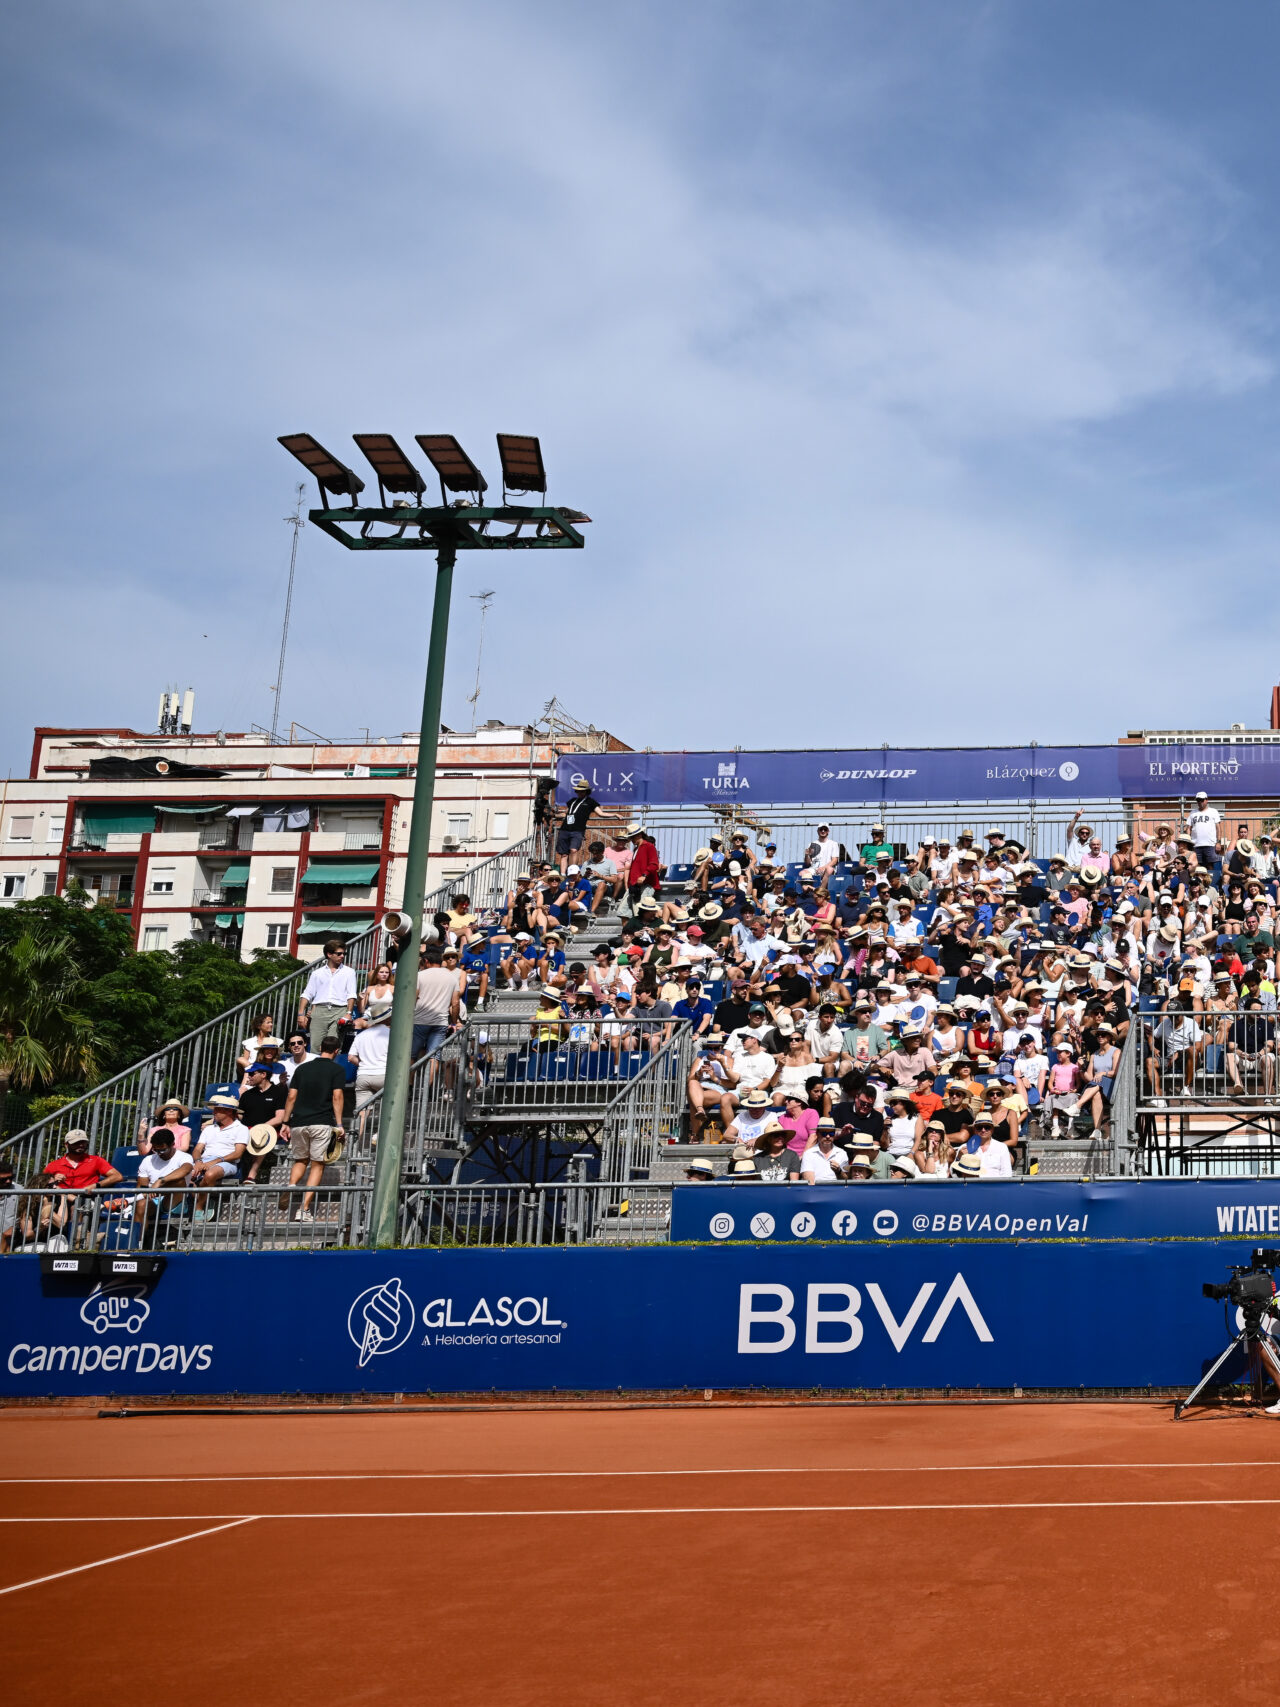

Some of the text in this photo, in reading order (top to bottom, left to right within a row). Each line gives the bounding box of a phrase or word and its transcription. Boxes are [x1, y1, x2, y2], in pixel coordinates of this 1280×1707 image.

[836, 769, 917, 780] DUNLOP
[1149, 759, 1240, 775] EL PORTEÑO
[703, 777, 750, 789] TURIA
[912, 1213, 1089, 1235] @BBVAOpenVal
[422, 1296, 562, 1328] GLASOL
[737, 1272, 995, 1354] BBVA
[435, 1334, 498, 1346] Heladería
[500, 1333, 561, 1345] artesanal
[7, 1343, 213, 1375] CamperDays
